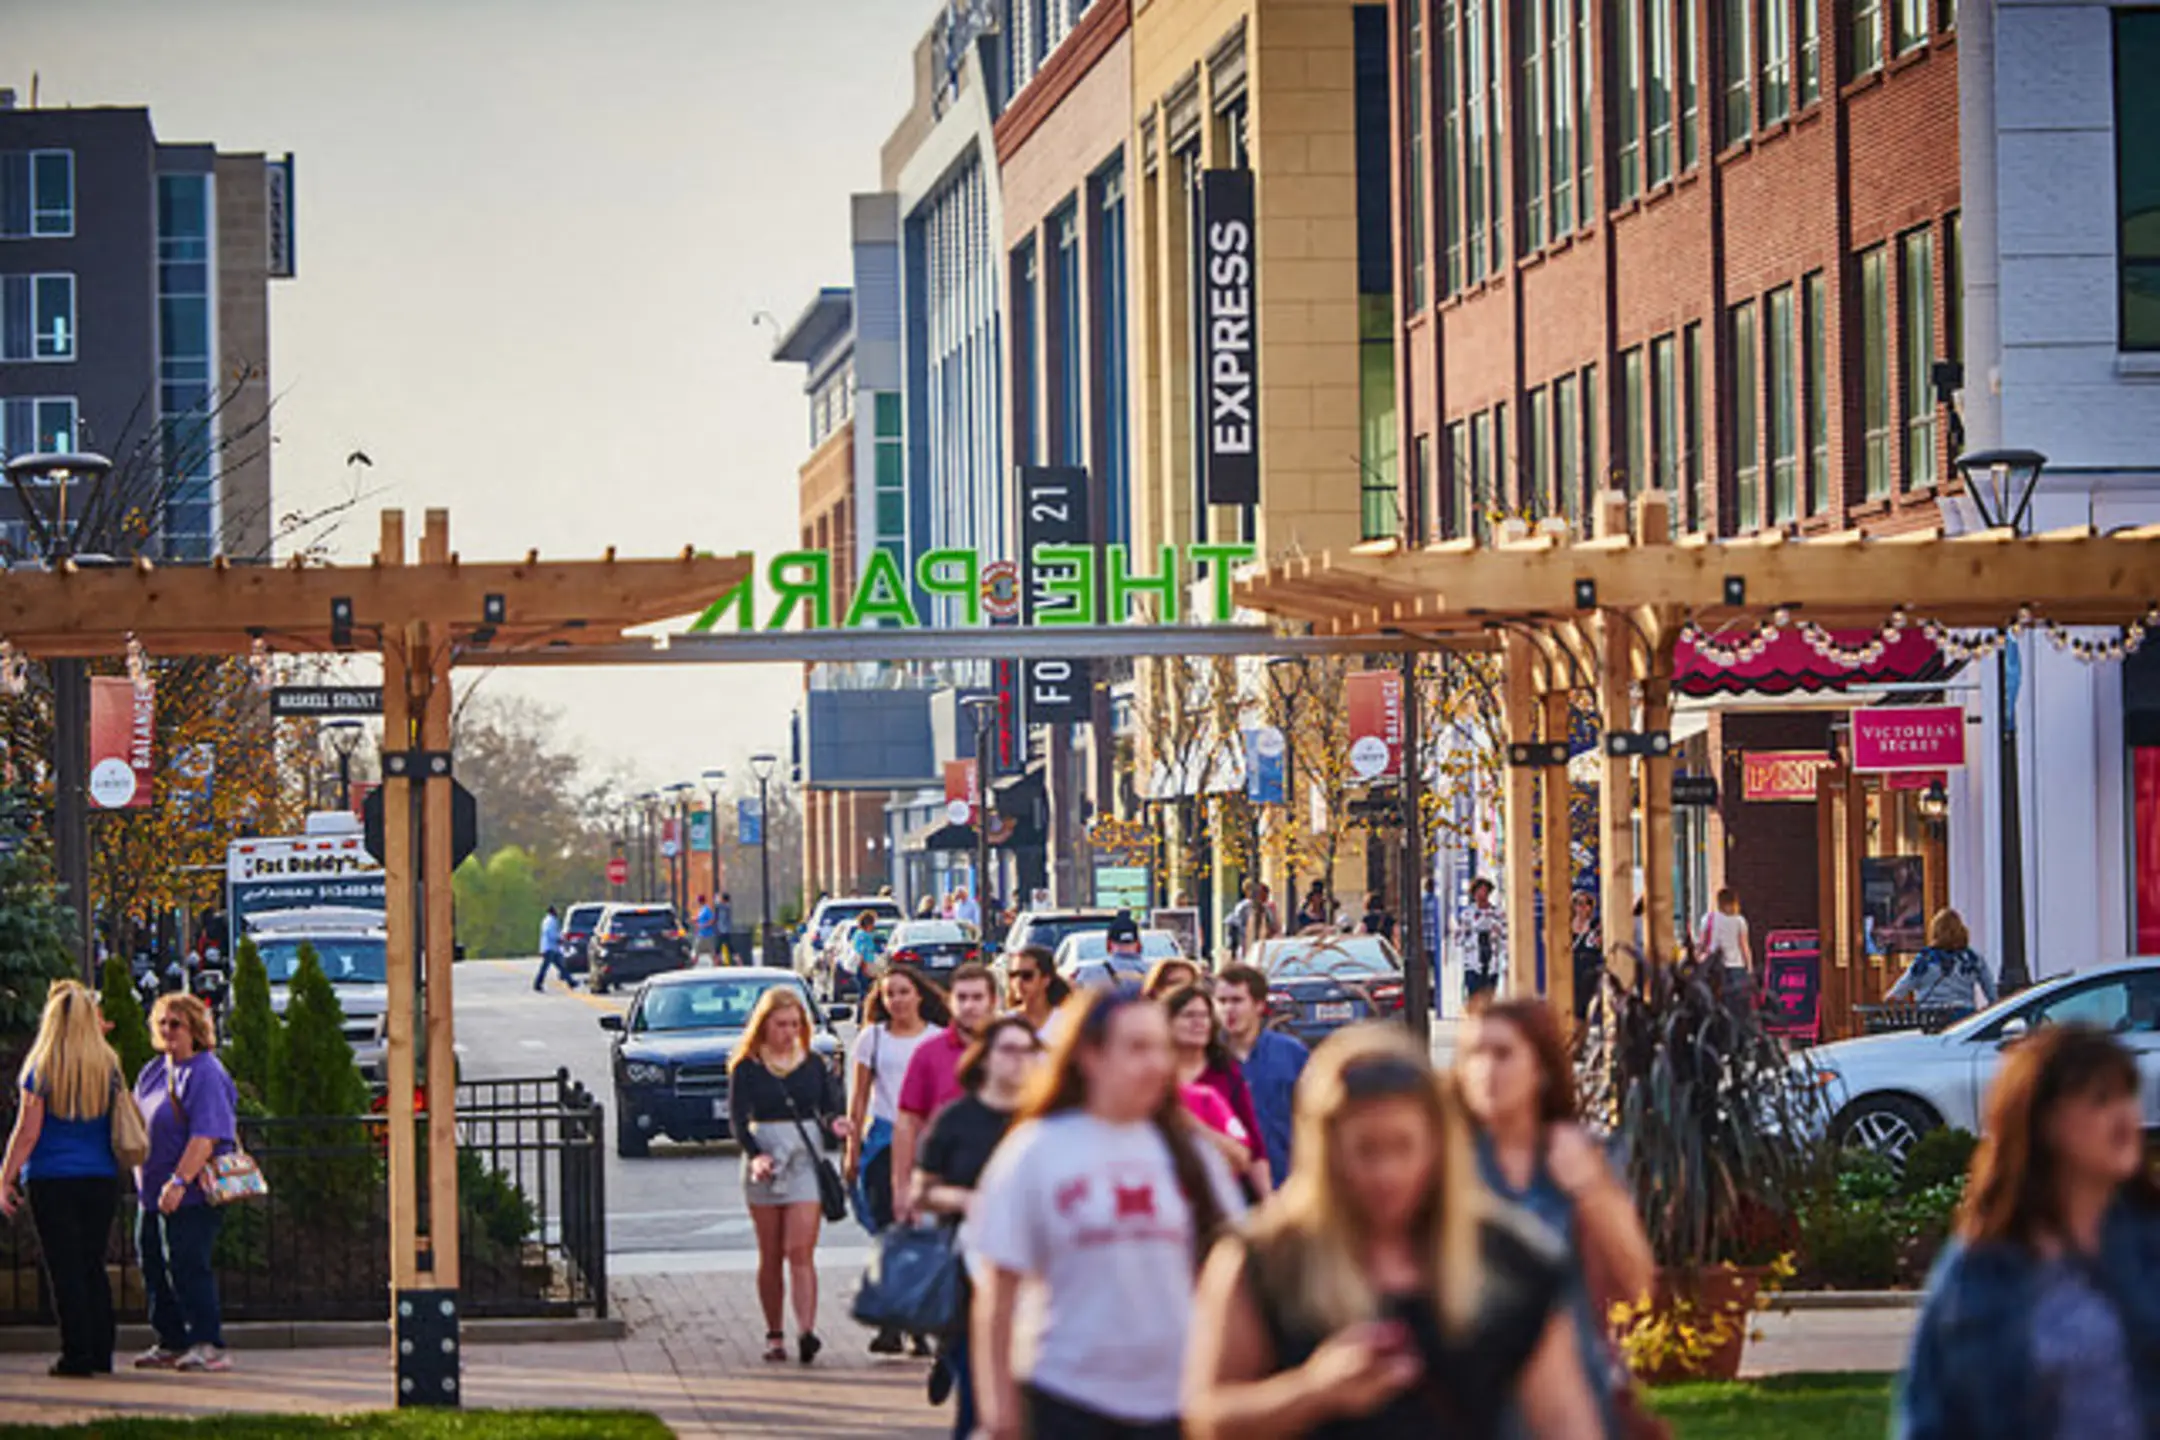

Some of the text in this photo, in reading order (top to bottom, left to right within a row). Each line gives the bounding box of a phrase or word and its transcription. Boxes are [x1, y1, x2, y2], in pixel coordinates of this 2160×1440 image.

[1210, 220, 1251, 454] EXPRESS
[1032, 486, 1071, 703] FOVE 21
[131, 690, 153, 769] BALANCE
[1382, 680, 1398, 744] BALANCE
[1861, 724, 1957, 739] VICTORIA'S
[1751, 761, 1837, 792] PIN
[1879, 739, 1940, 752] SECRET
